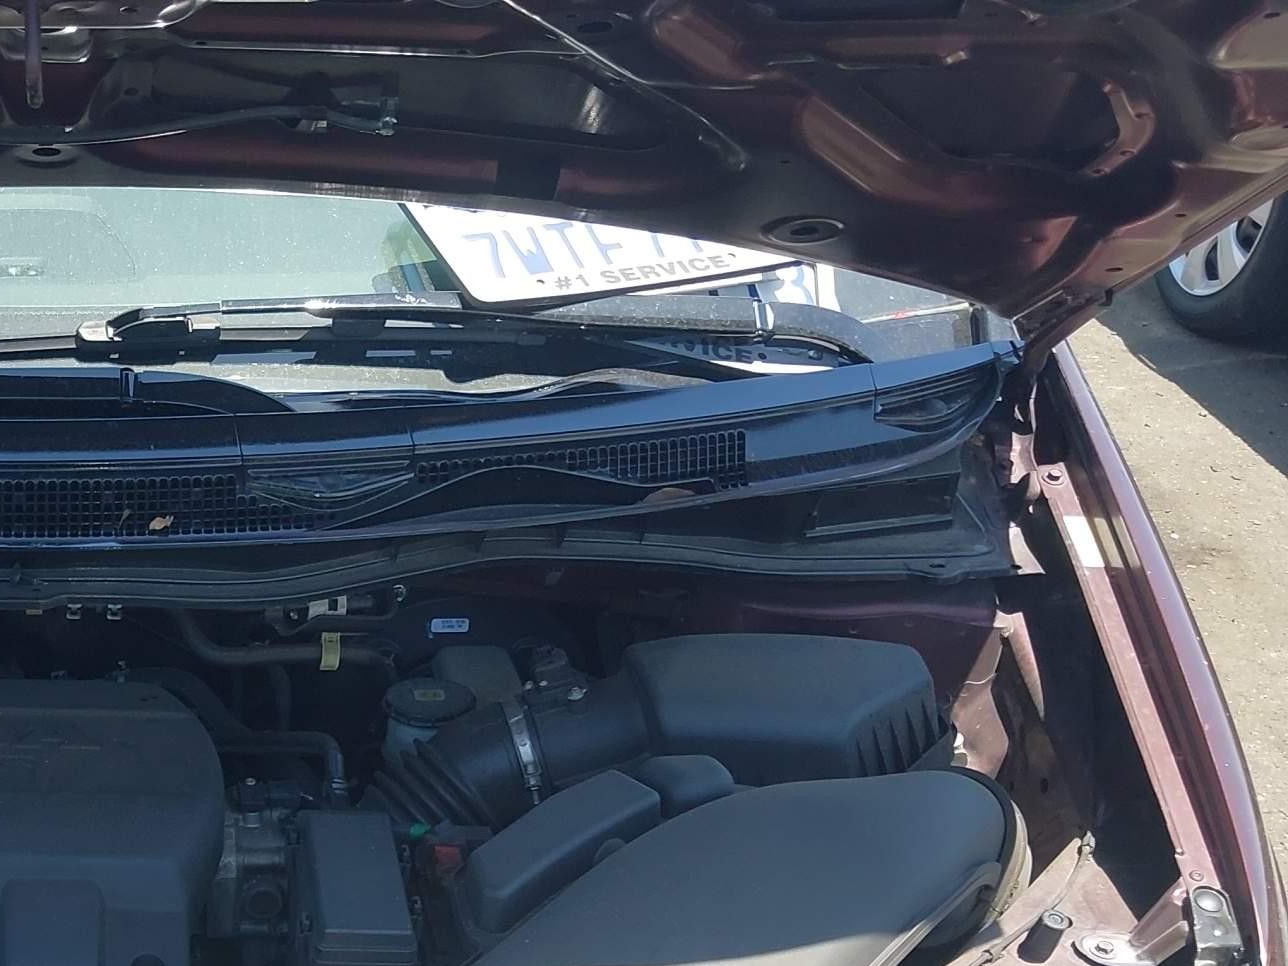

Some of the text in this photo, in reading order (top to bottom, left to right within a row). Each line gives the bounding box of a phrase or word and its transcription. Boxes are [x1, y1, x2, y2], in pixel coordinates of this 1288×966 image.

[461, 221, 704, 279] 7WTF
[554, 254, 731, 291] #1 SERVICE
